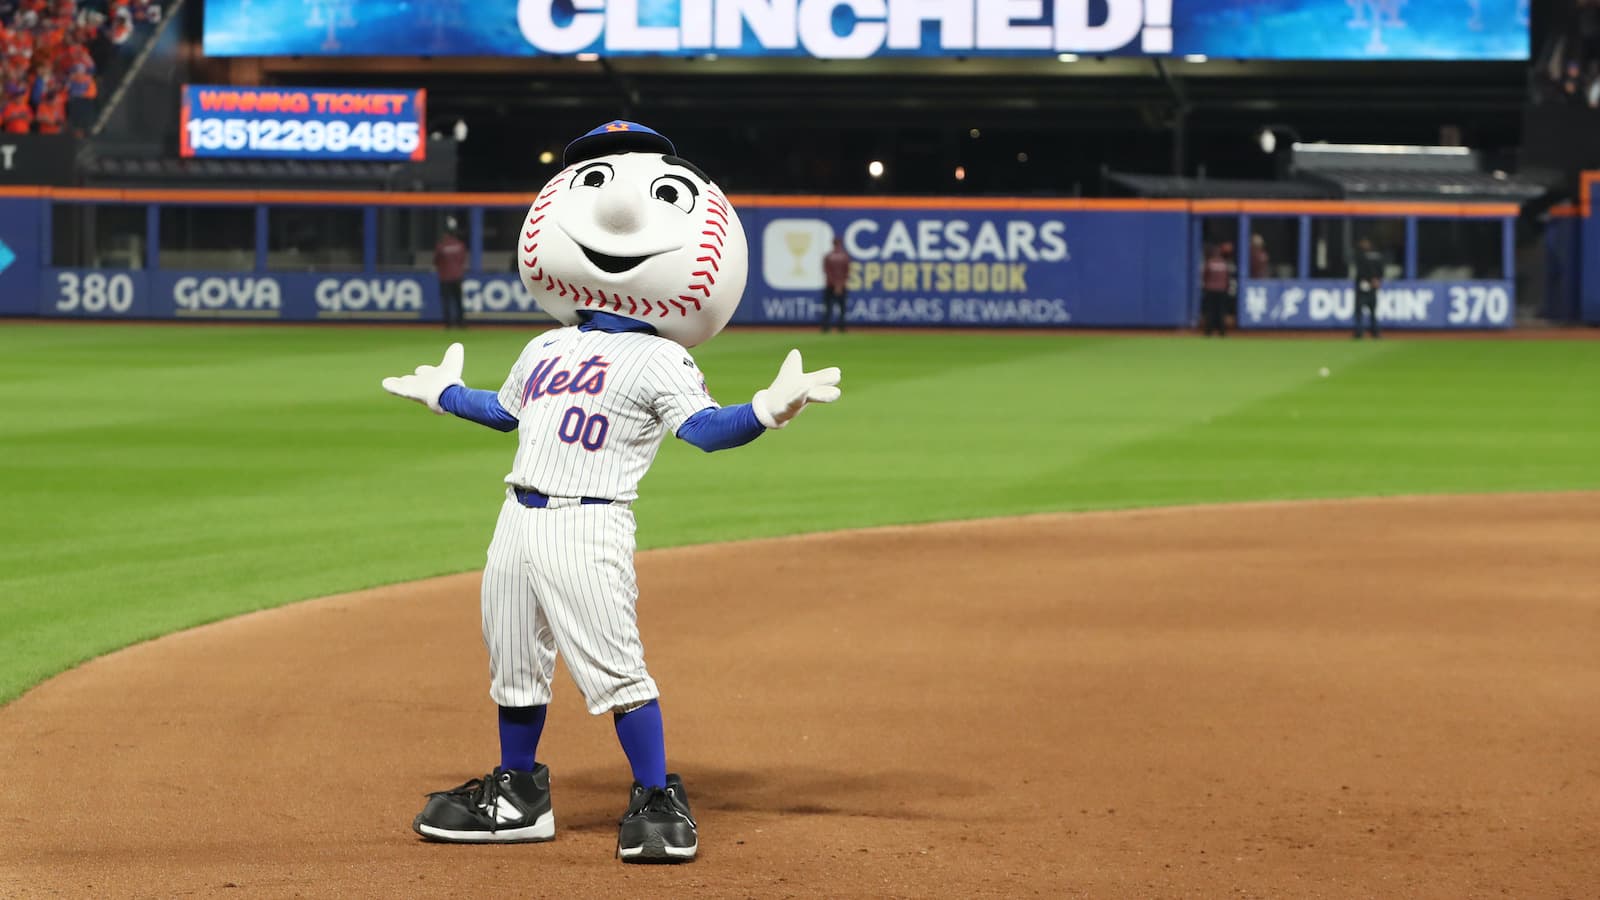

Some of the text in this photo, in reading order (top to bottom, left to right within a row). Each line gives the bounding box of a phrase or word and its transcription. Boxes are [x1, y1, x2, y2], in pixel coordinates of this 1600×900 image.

[517, 0, 1174, 58] CLINCHED!
[199, 91, 408, 114] WINNING TICKET
[187, 119, 420, 153] 13512298485
[843, 218, 1068, 261] CAESARS
[56, 272, 134, 313] 380
[174, 277, 281, 312] GOYA
[847, 262, 1027, 292] SPORTSBOOK
[316, 278, 423, 312] GOYA
[463, 279, 543, 311] GOY
[1309, 289, 1434, 321] DUKIN'
[1448, 287, 1509, 323] 370
[522, 355, 611, 408] Mets
[558, 406, 609, 452] 00
